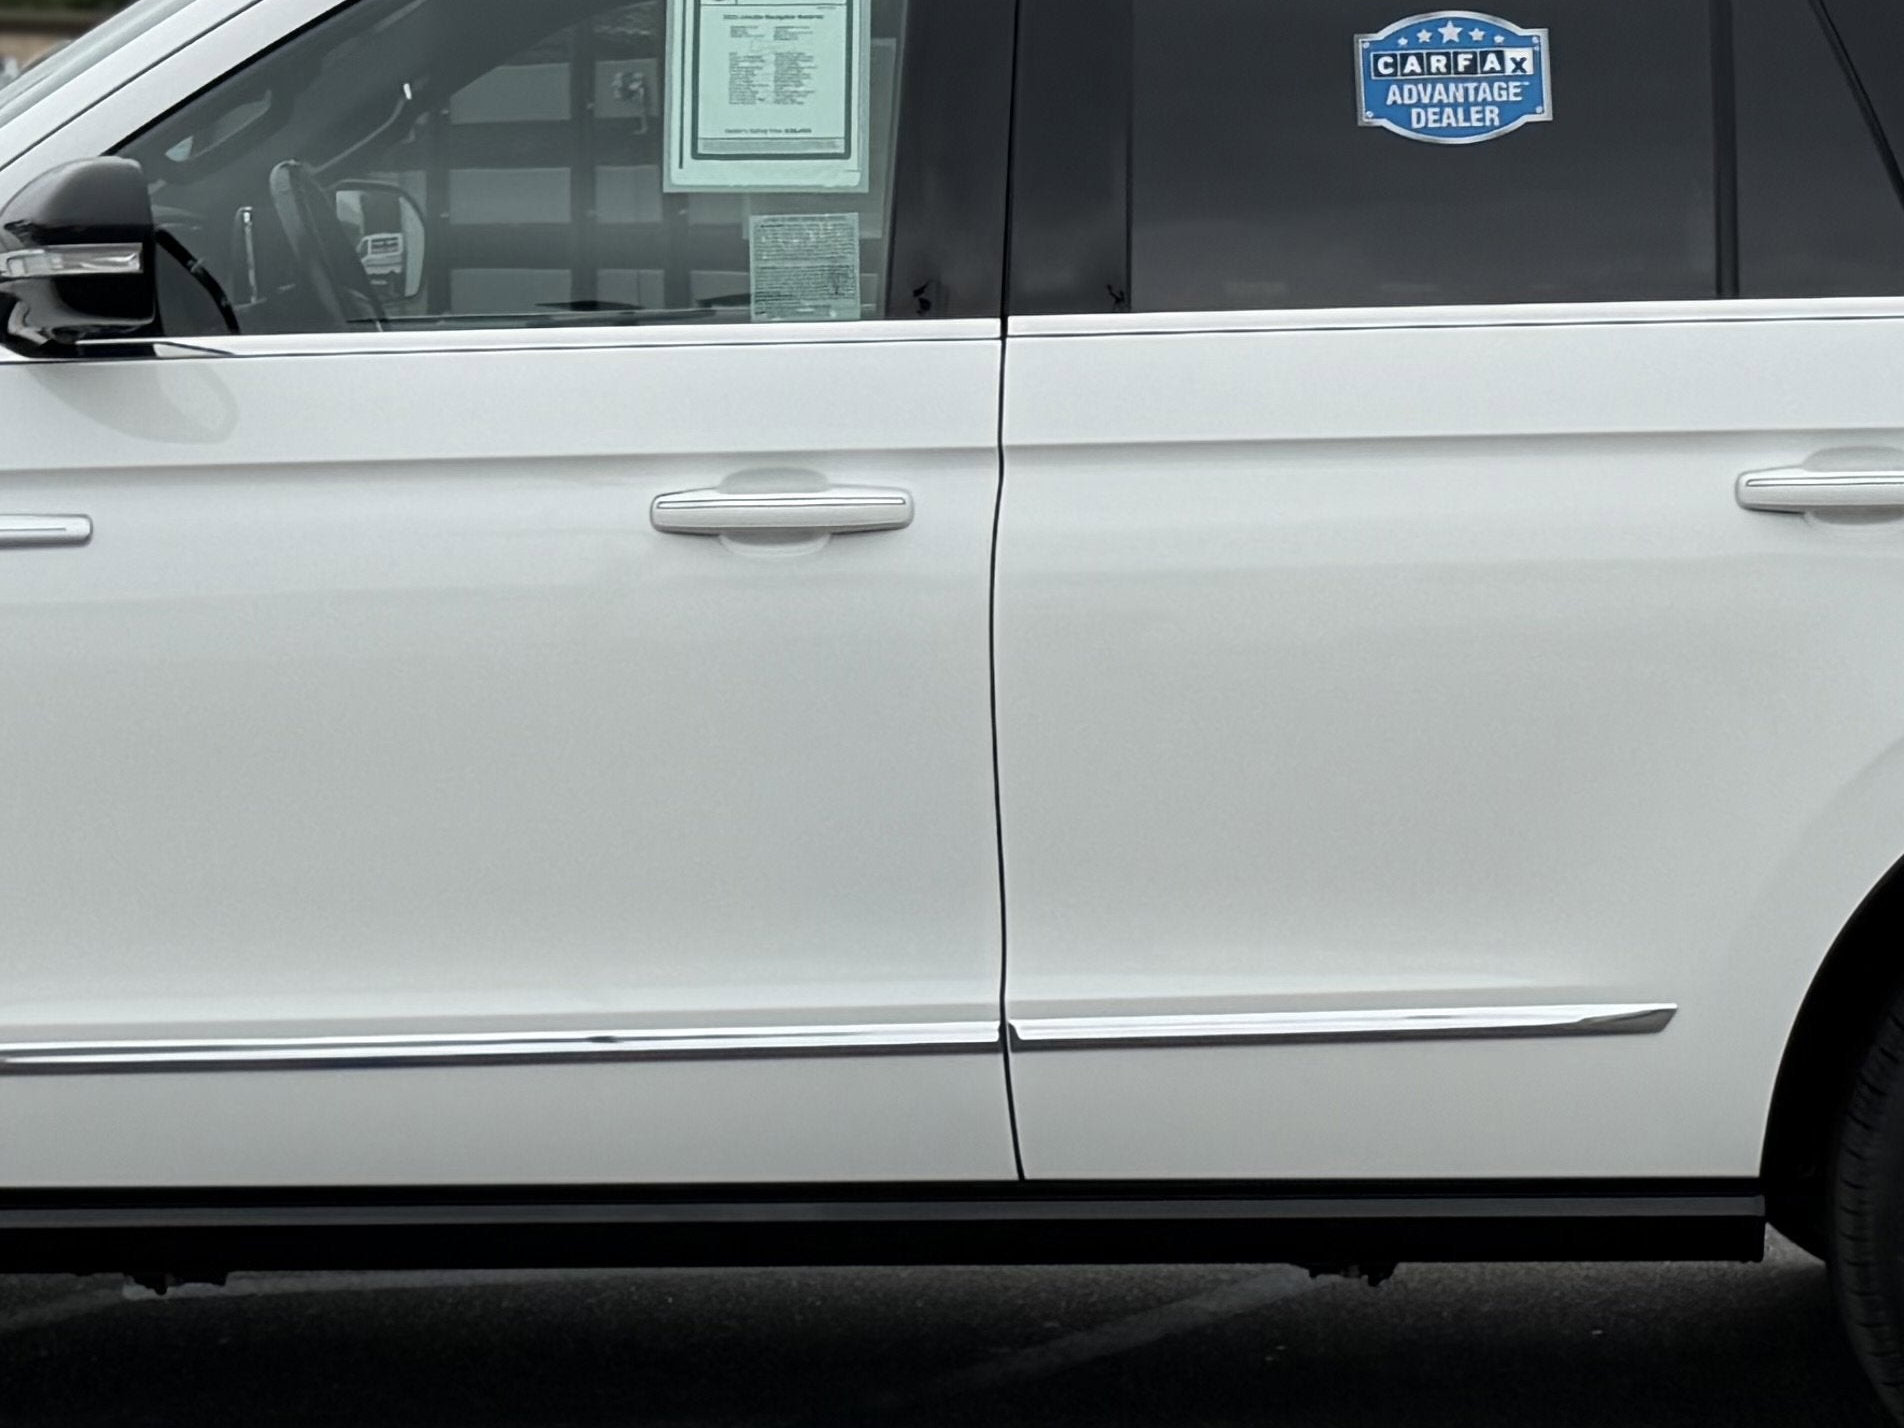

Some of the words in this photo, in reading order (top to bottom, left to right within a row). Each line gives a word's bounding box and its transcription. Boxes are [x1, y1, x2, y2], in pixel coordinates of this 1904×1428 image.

[1377, 50, 1527, 75] CARFAX
[1386, 82, 1523, 105] ADVANTAGE
[1411, 106, 1500, 129] DEALER
